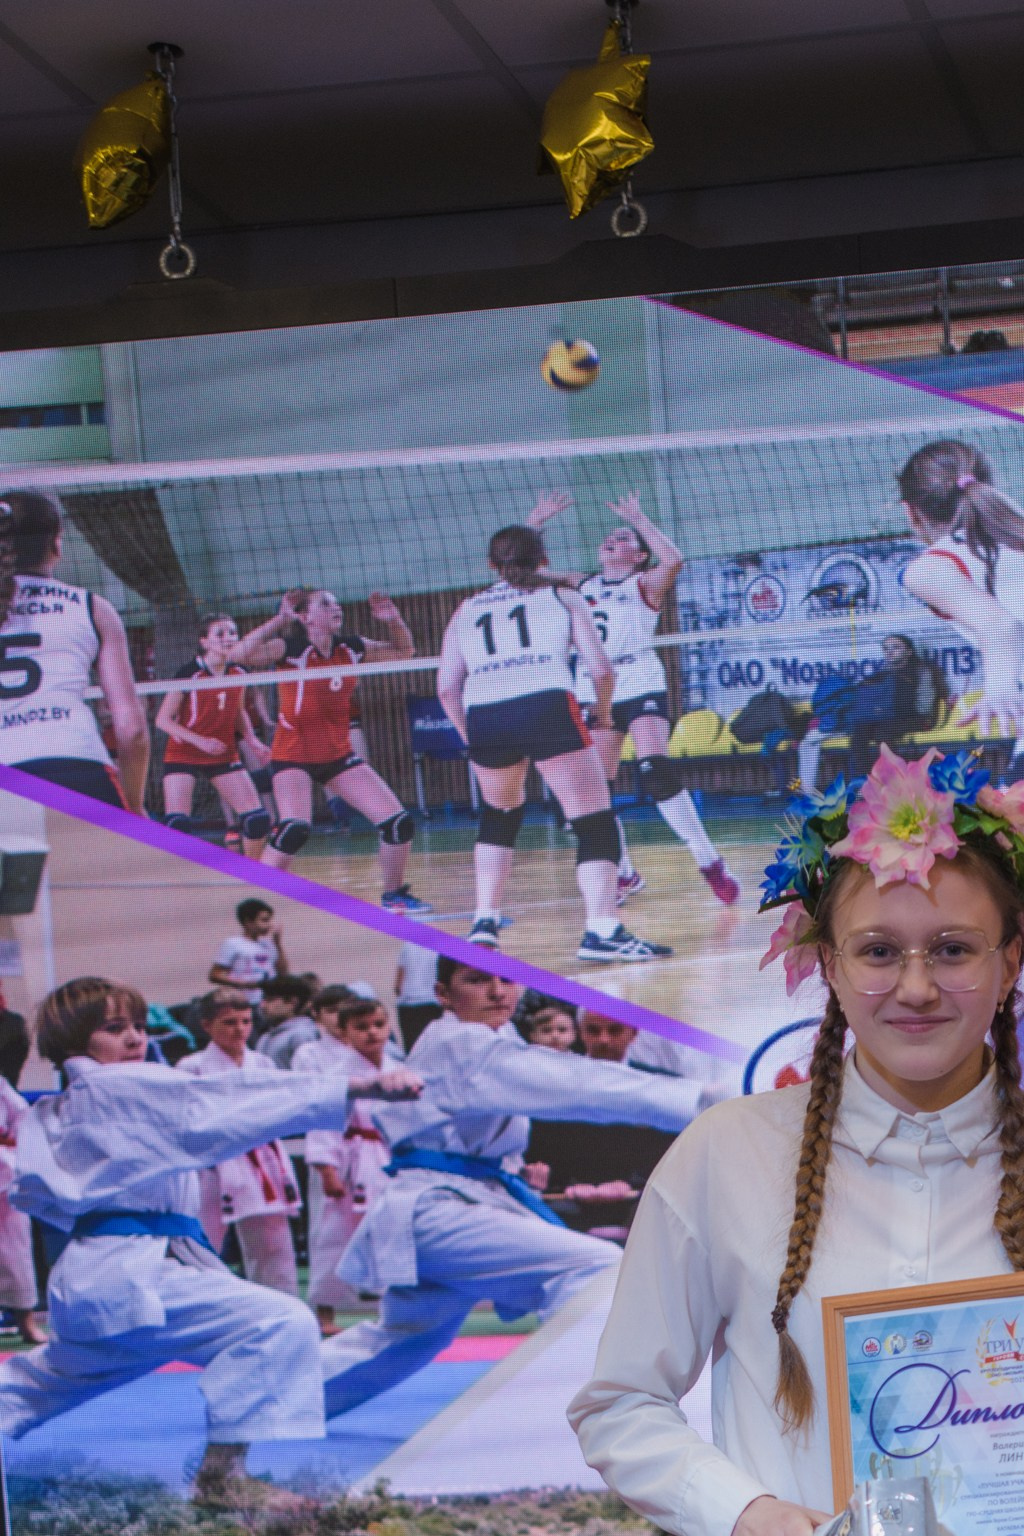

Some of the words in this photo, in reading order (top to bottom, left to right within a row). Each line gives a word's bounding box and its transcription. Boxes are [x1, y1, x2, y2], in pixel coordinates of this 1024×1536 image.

[474, 603, 532, 656] 11
[716, 660, 764, 689] ОАО
[998, 1452, 1024, 1464] ЛИН
